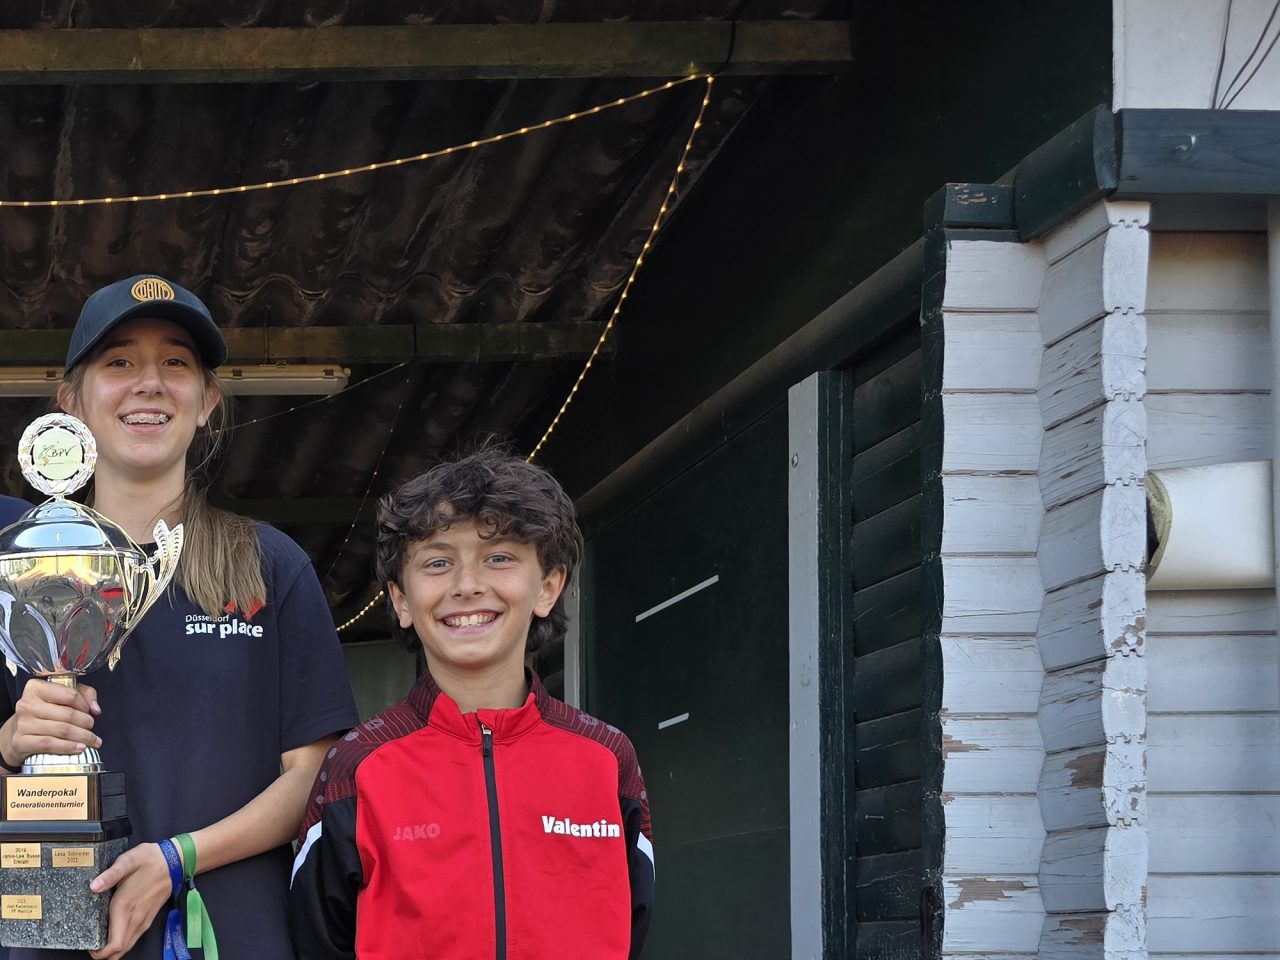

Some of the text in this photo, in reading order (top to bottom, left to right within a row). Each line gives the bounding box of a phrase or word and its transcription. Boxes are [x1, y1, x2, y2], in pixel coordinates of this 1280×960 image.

[185, 614, 230, 622] Düsselorf
[185, 618, 263, 639] sur place
[17, 788, 78, 798] Wanderpokal
[393, 823, 441, 841] JAKO
[541, 815, 621, 838] Valentin
